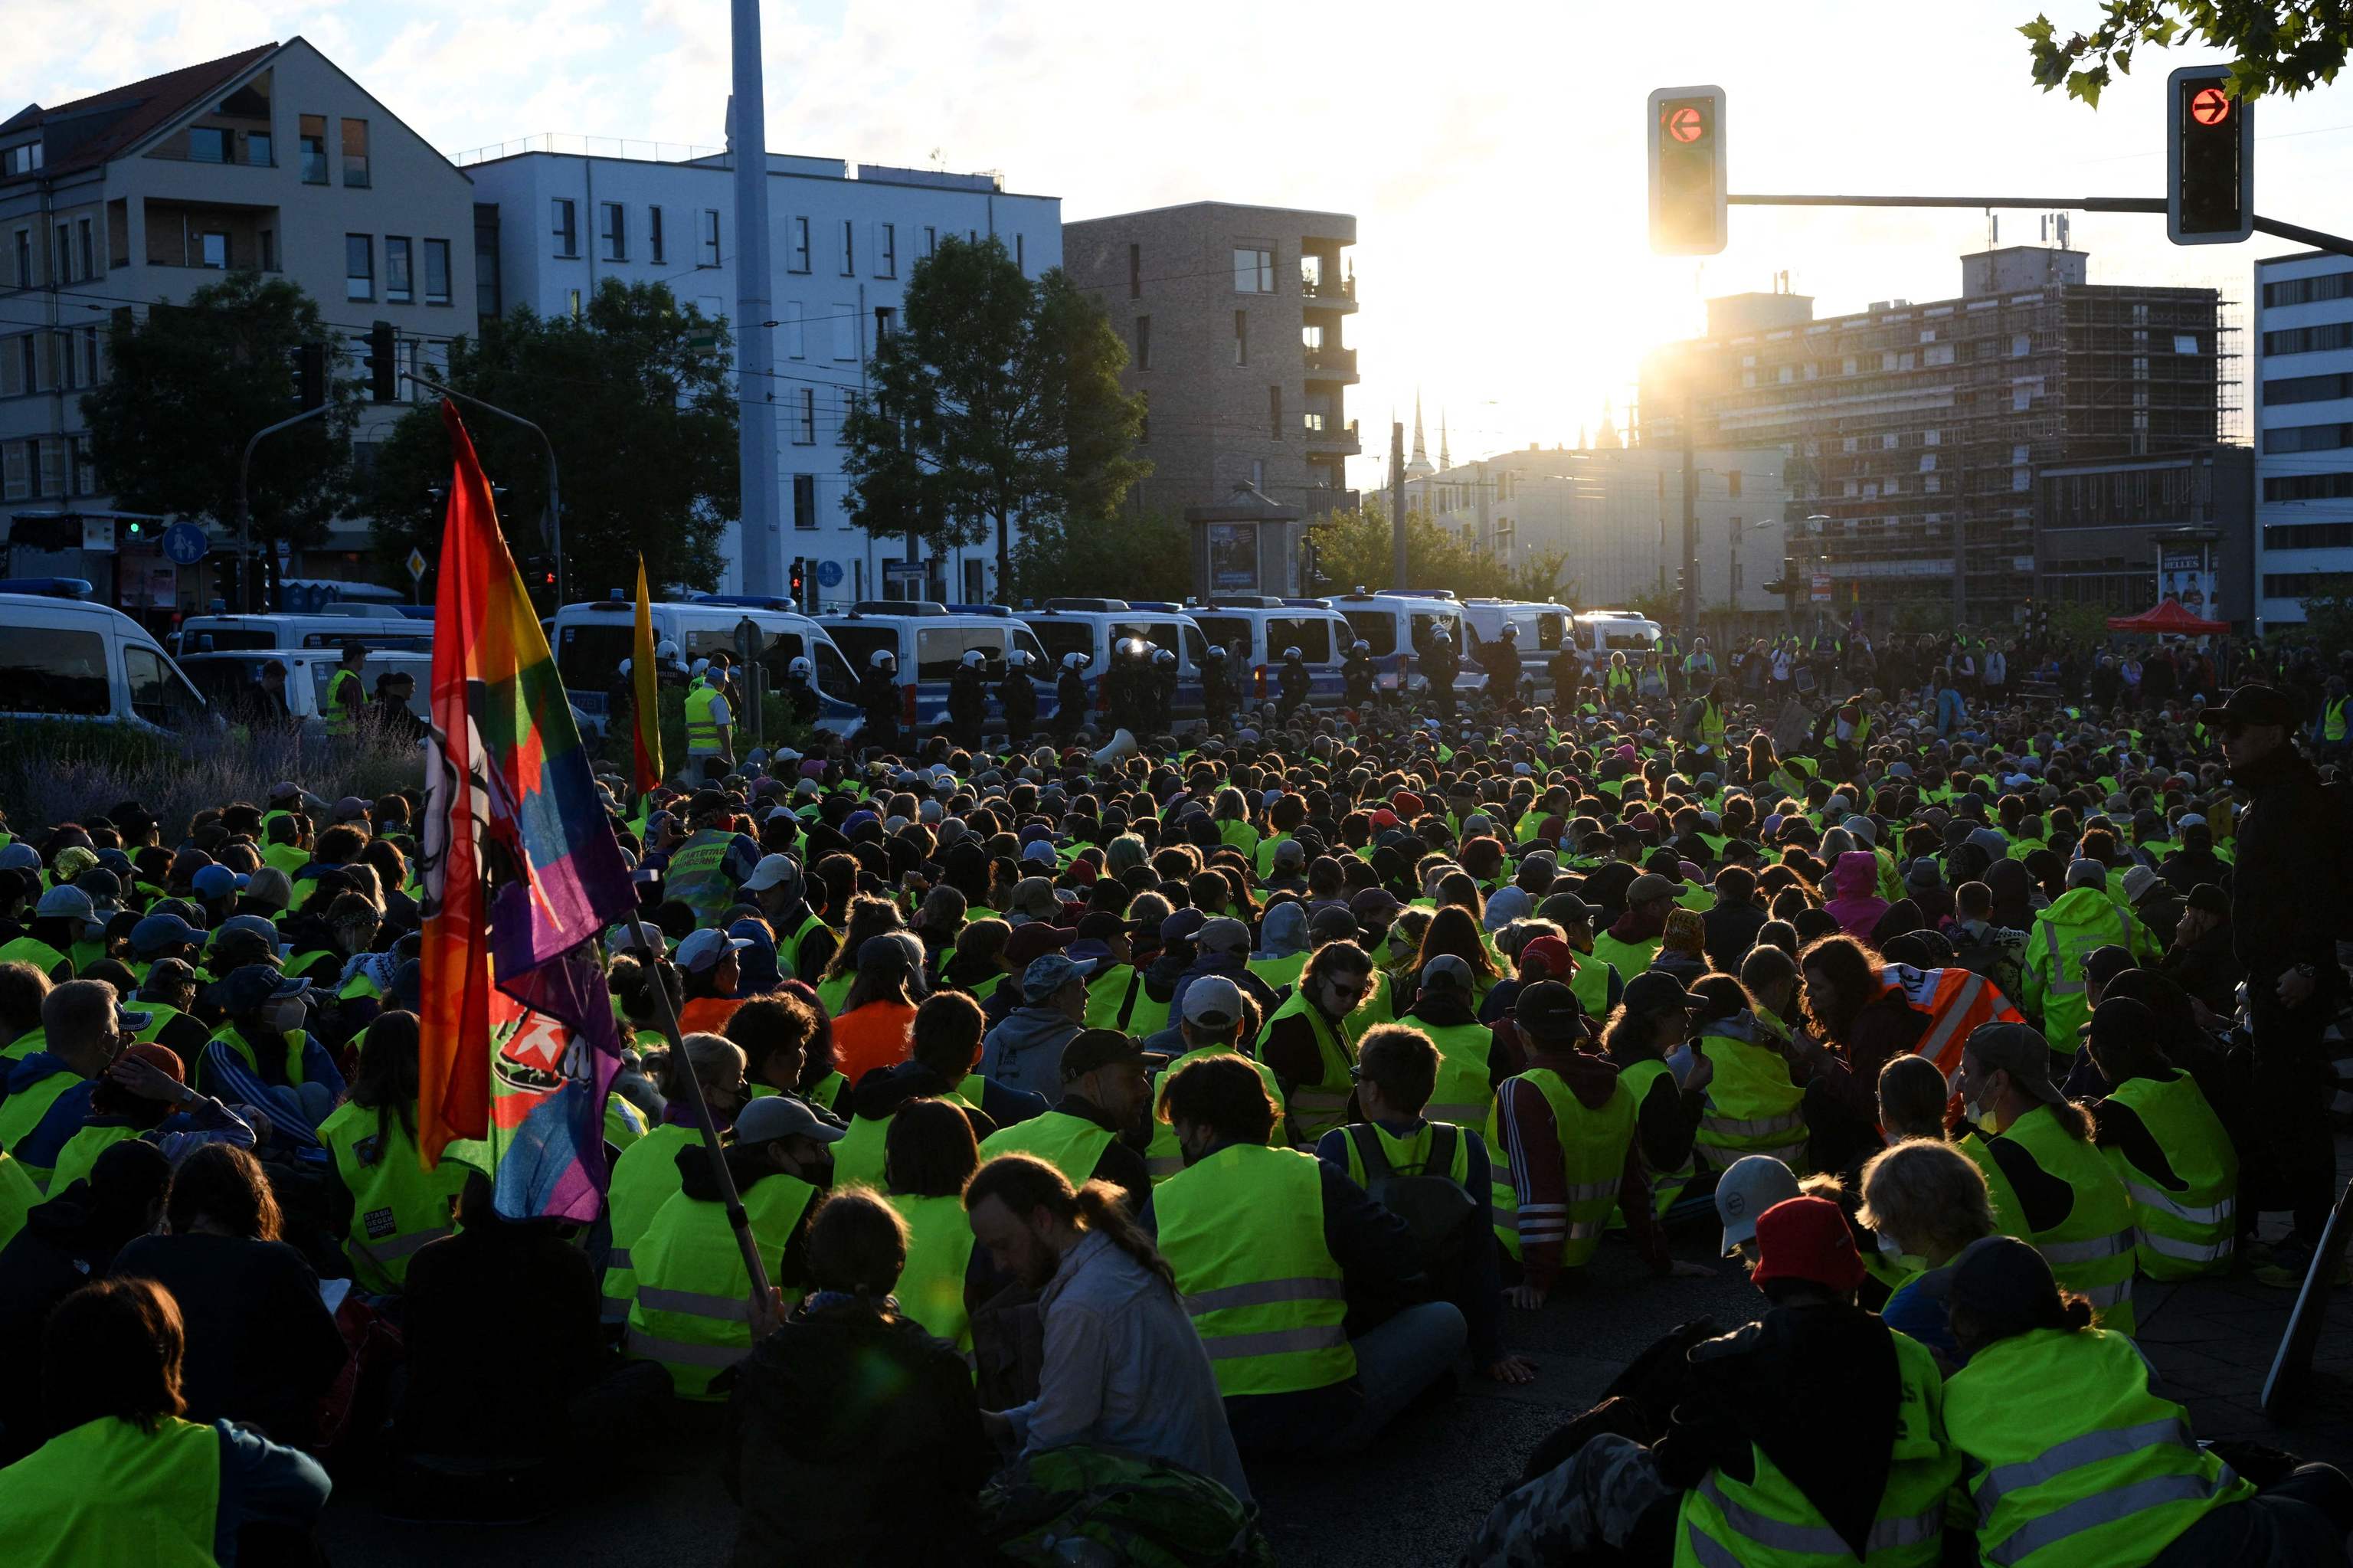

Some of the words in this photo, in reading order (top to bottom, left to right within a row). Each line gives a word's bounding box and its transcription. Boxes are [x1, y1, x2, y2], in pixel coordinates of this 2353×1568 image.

[2164, 560, 2199, 570] HELLES
[365, 1209, 390, 1221] STABIL
[367, 1216, 393, 1227] GEGEN
[368, 1222, 394, 1233] RECHTS
